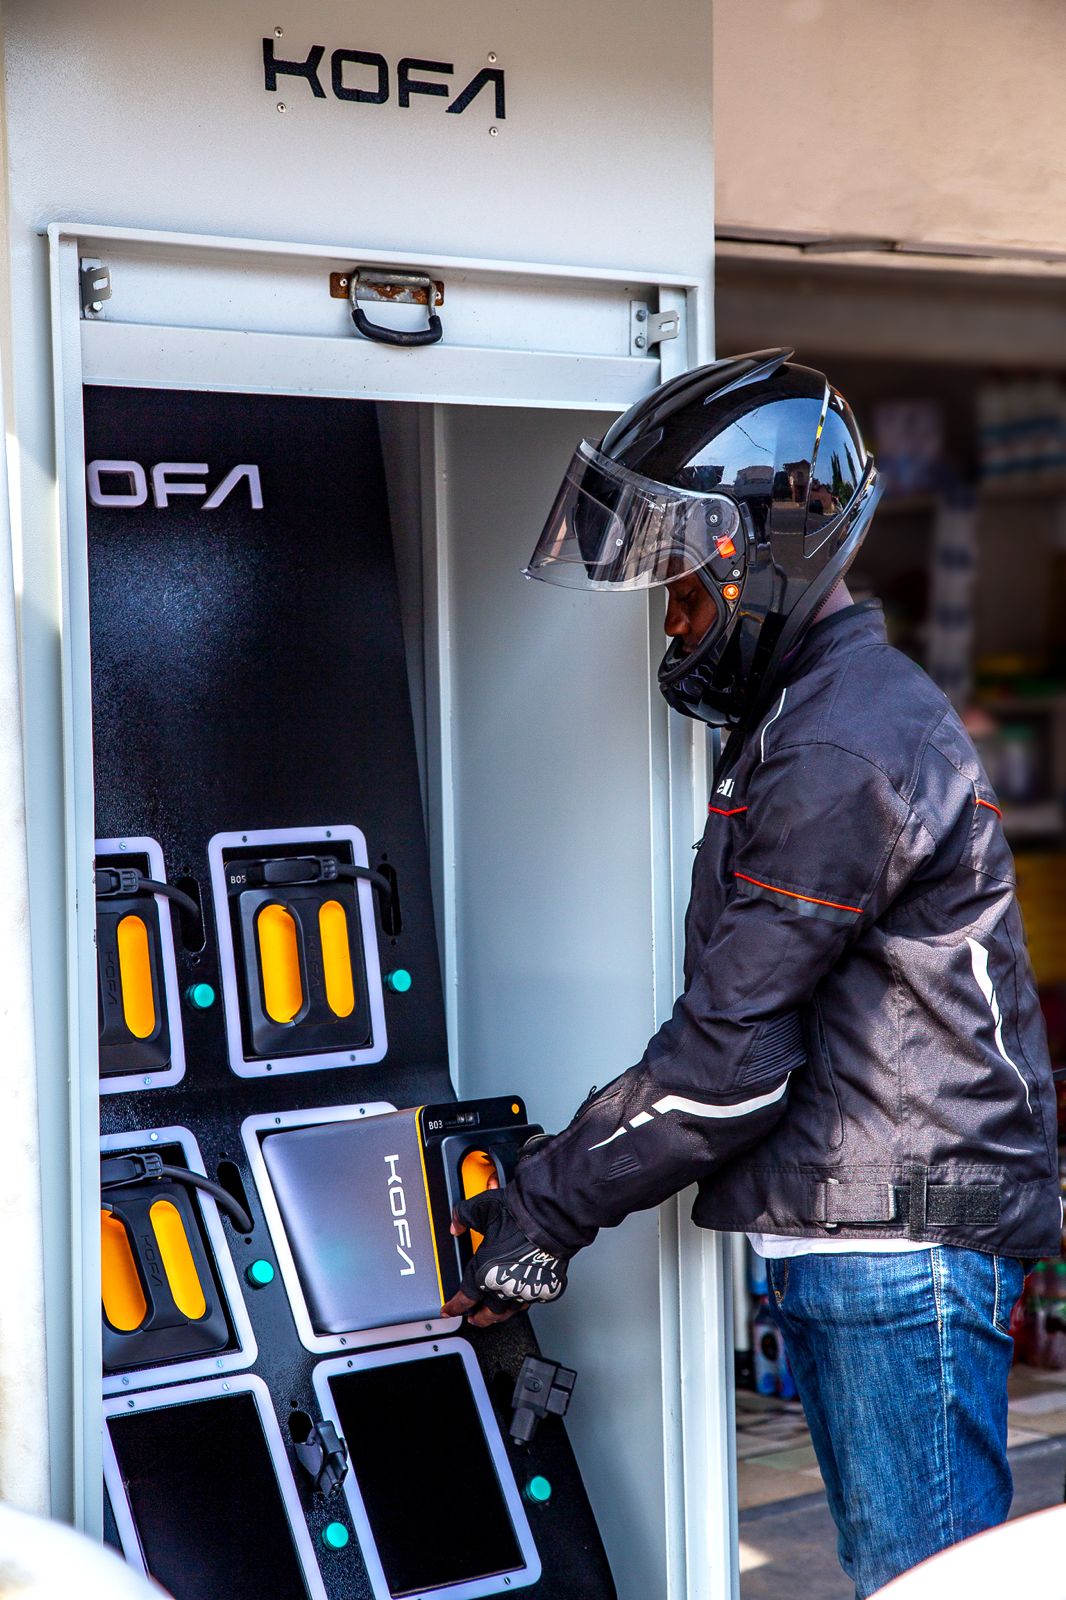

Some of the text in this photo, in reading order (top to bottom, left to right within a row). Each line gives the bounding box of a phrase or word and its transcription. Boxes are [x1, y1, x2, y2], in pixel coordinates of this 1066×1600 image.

[262, 37, 506, 119] KOFA
[86, 459, 264, 510] OFA
[230, 875, 247, 884] B05
[428, 1119, 443, 1130] B03
[383, 1154, 416, 1276] KOFA
[140, 1234, 163, 1287] KOFA
